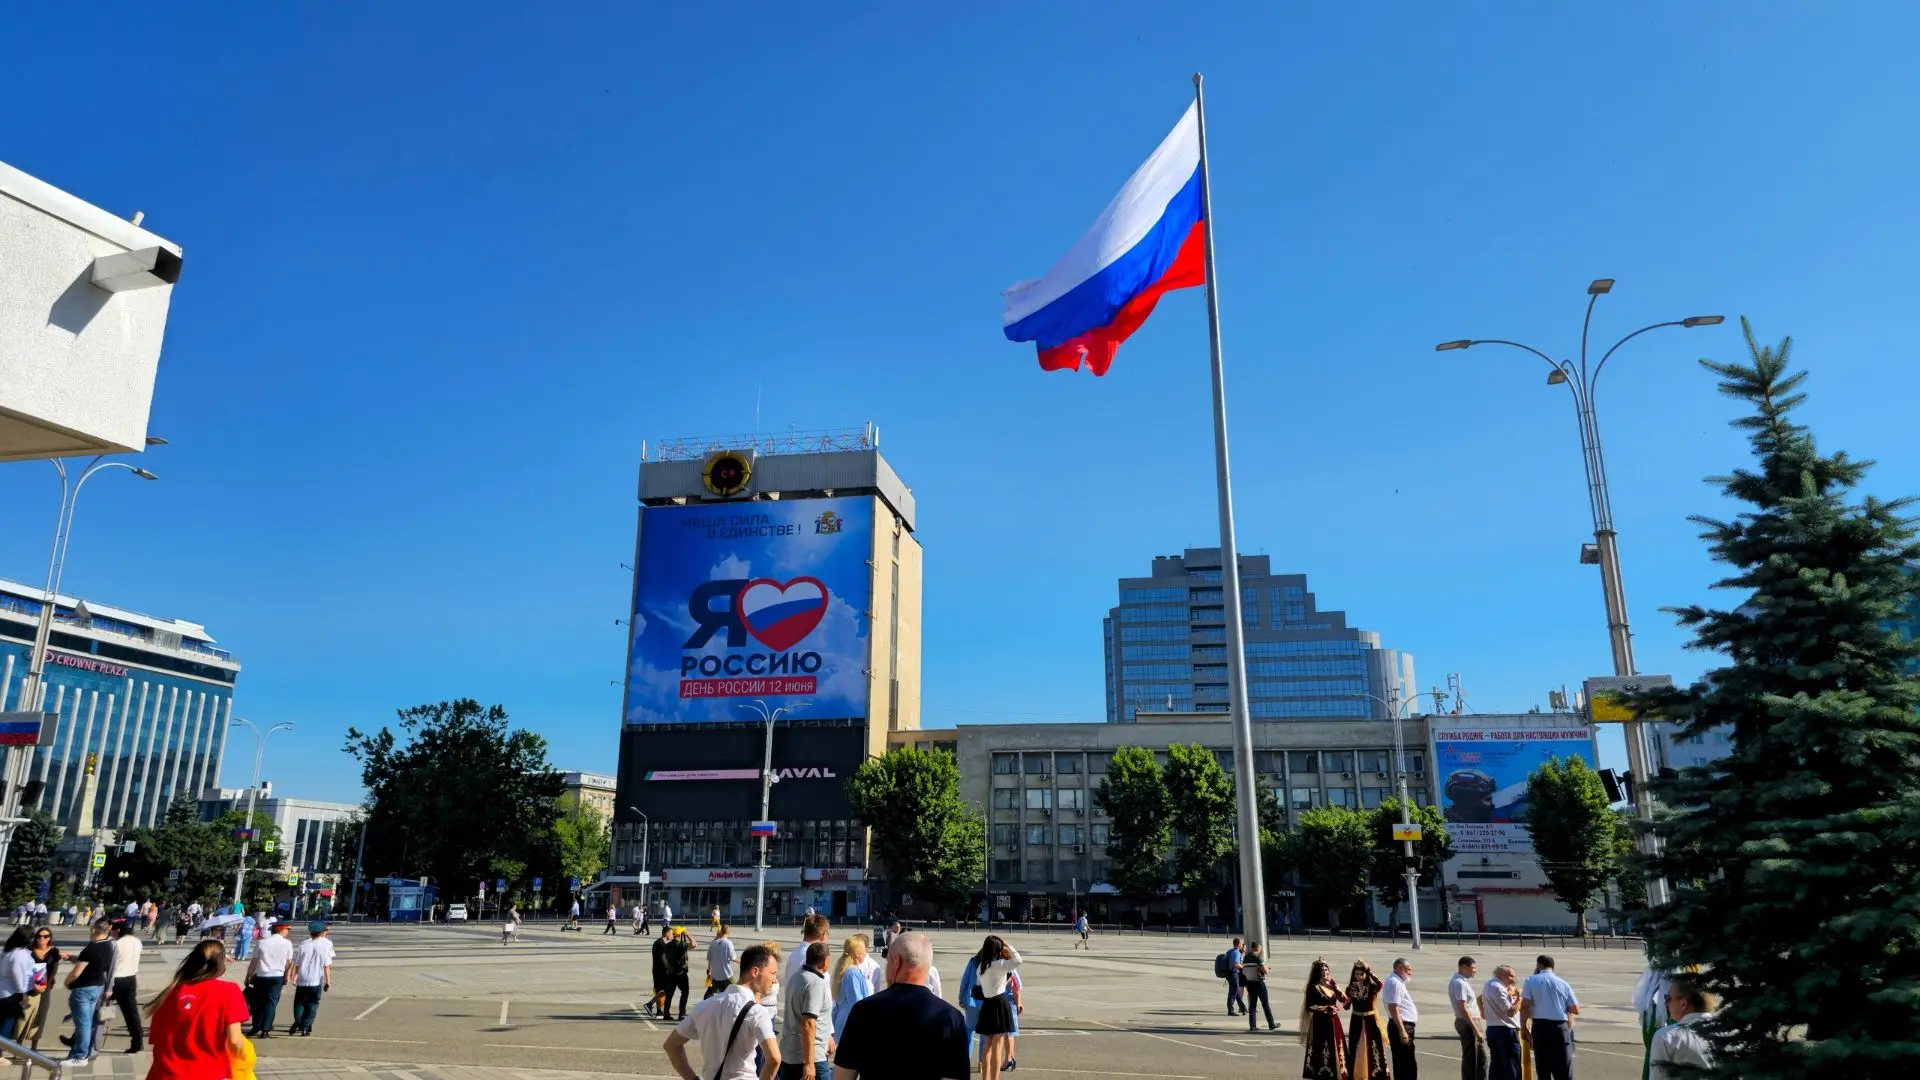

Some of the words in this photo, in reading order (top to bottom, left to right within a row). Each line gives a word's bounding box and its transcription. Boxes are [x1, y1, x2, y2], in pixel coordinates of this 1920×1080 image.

[681, 517, 725, 528] НАША
[730, 514, 770, 526] СИЛА
[707, 528, 716, 539] В
[720, 525, 794, 540] ЕДИНСТВЕ
[682, 579, 749, 649] Я
[57, 655, 97, 672] CROWNE
[99, 663, 128, 677] PLAZA
[681, 651, 822, 677] РОССИЮ
[684, 682, 714, 697] ДЕНЬ
[718, 680, 765, 694] РОССИИ
[770, 680, 781, 692] 12
[785, 681, 813, 692] июня
[1490, 731, 1512, 740] РАБОТА
[708, 871, 733, 880] Альфа
[734, 871, 752, 879] Банк
